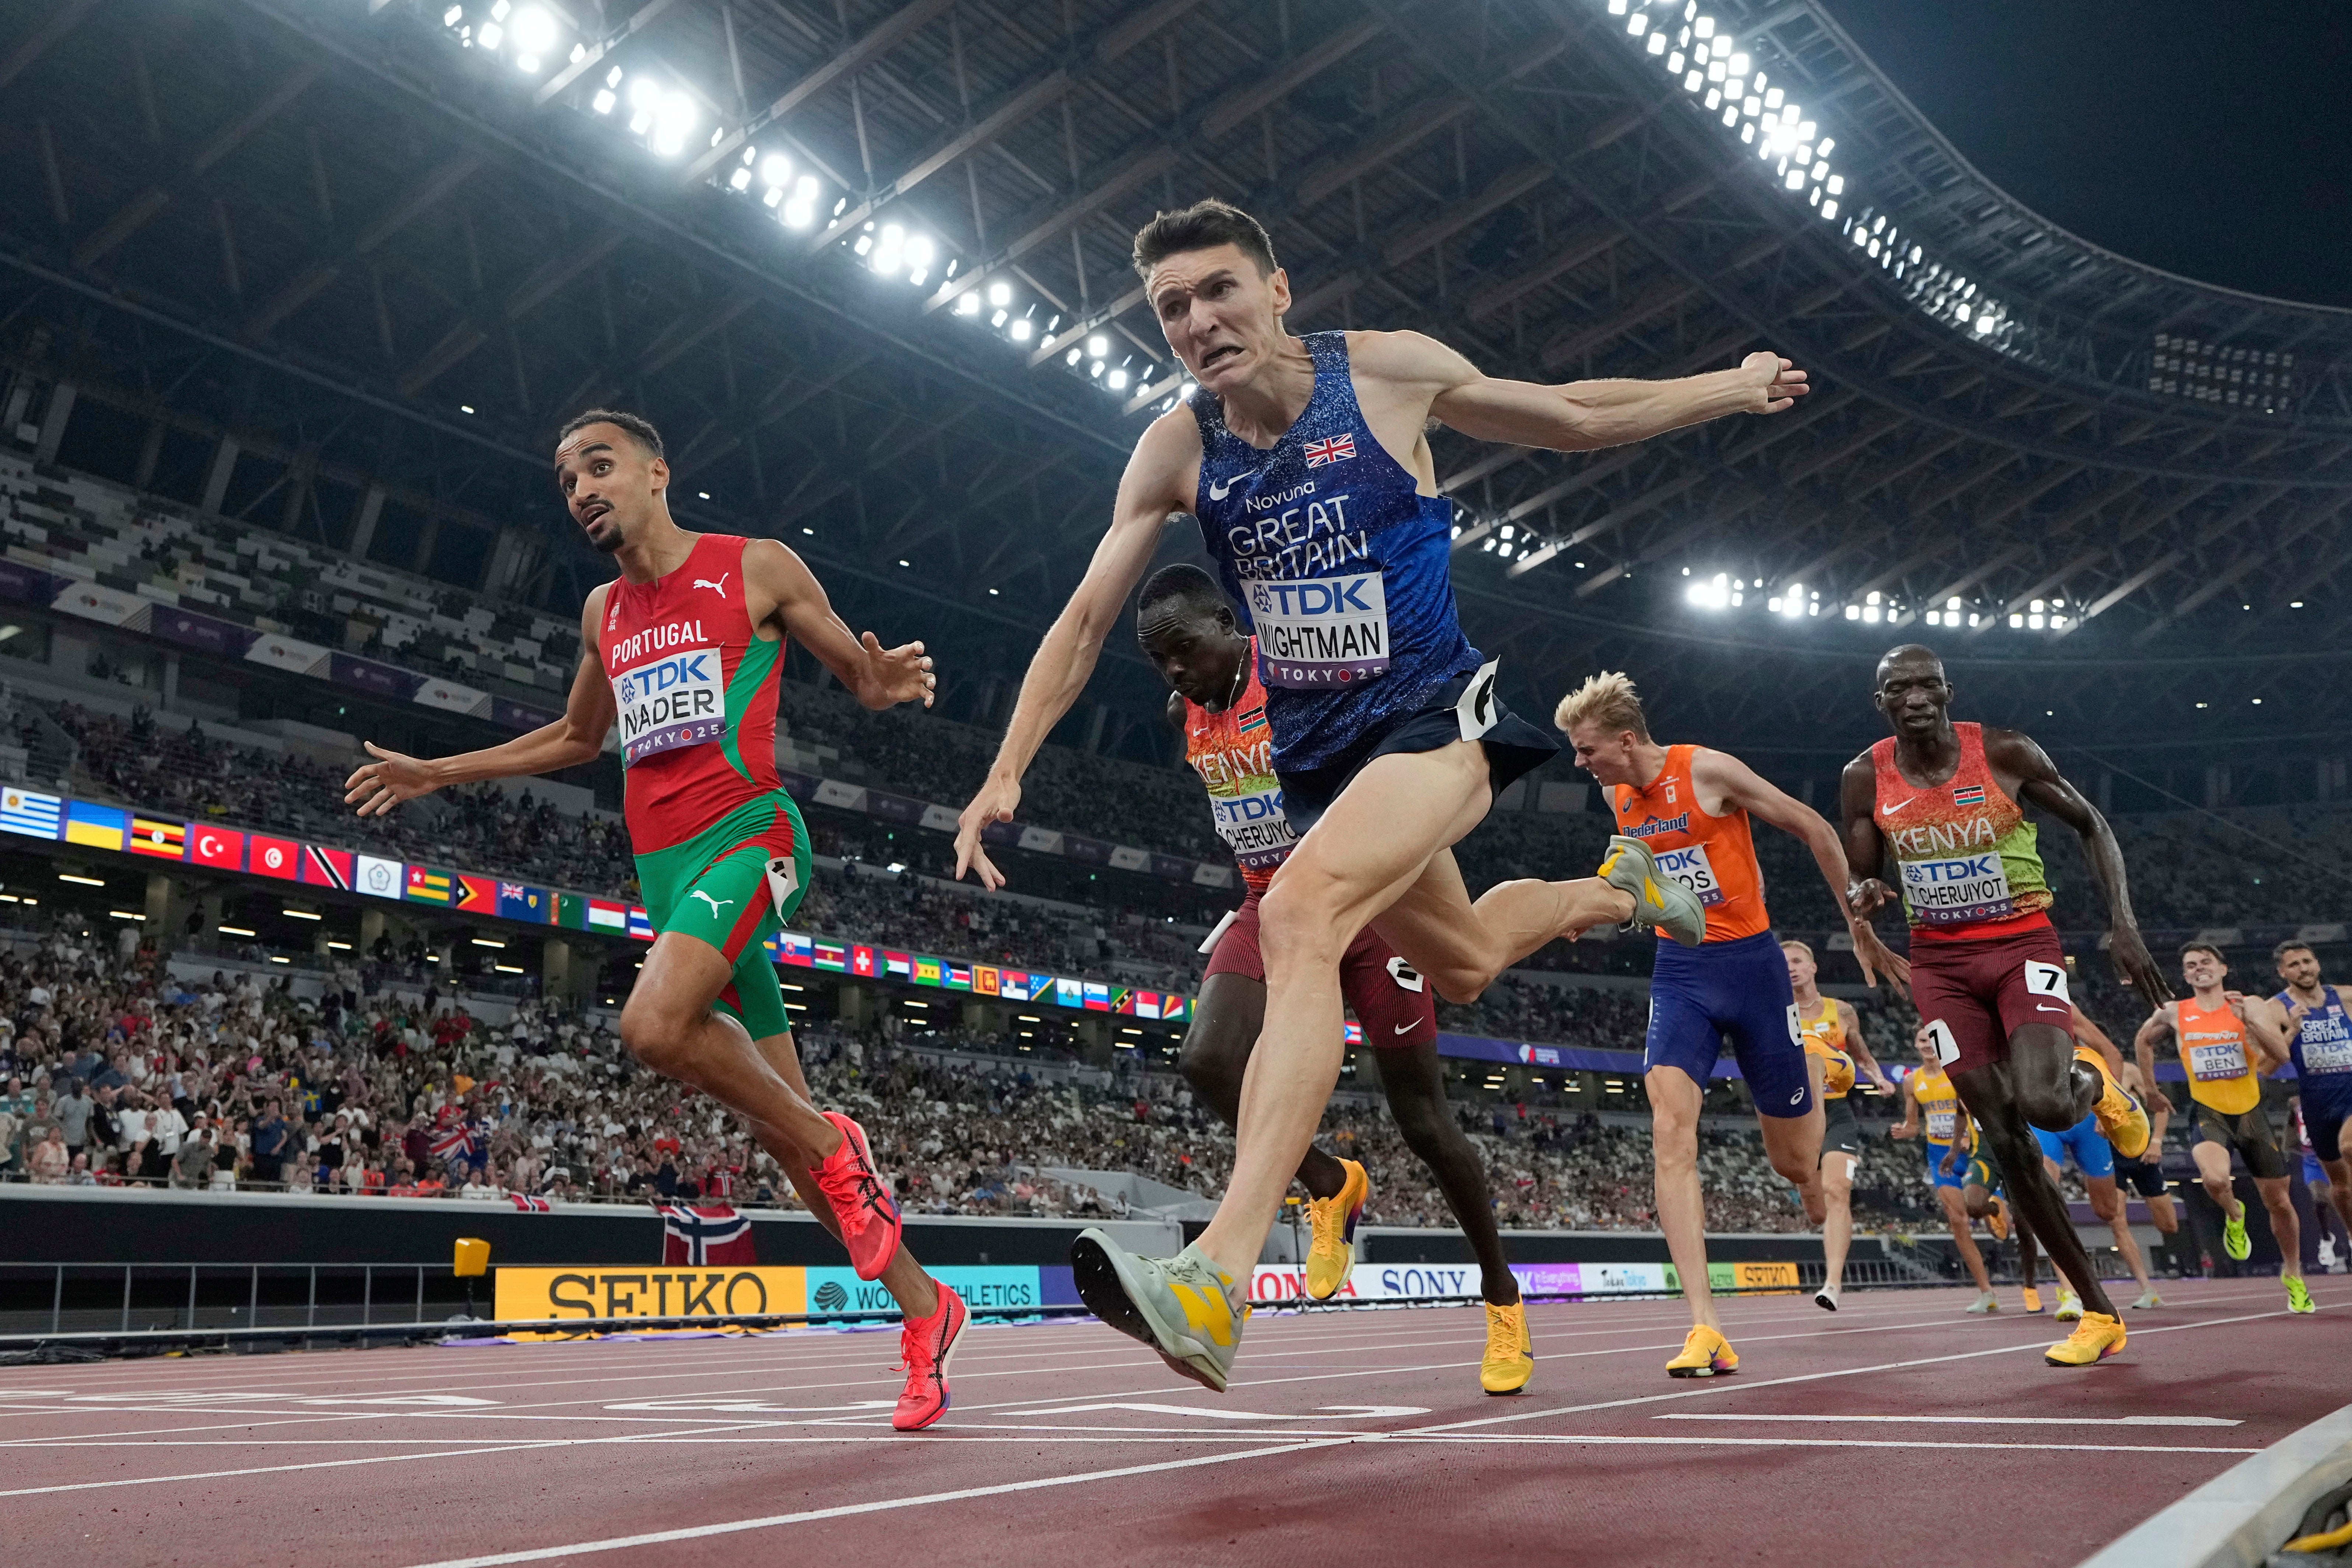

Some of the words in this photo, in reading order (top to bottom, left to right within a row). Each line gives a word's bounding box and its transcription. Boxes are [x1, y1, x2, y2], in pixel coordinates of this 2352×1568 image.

[1246, 481, 1315, 513] Novuna
[1228, 495, 1349, 557] GREAT
[1234, 530, 1368, 581] BRITAIN
[1269, 578, 1373, 615] TDK
[611, 619, 708, 670] PORTUGAL
[1259, 621, 1380, 659] WIGHTMAN
[633, 654, 711, 696] TDK
[624, 689, 714, 740] NADER
[1192, 740, 1272, 784] KENYA
[1222, 793, 1283, 822] TDK
[1891, 817, 1996, 856] KENYA
[1921, 856, 1994, 881] TDK
[2038, 969, 2060, 991] 7
[2301, 1017, 2341, 1032] GREAT
[2301, 1027, 2349, 1043] BRITAIN
[2204, 1043, 2239, 1057] TDK
[2205, 1058, 2235, 1070] BEN
[1383, 1269, 1466, 1295] SONY
[1744, 1266, 1791, 1286] SEIKO
[549, 1272, 766, 1319] SEIKO
[950, 1284, 1030, 1306] HLETICS
